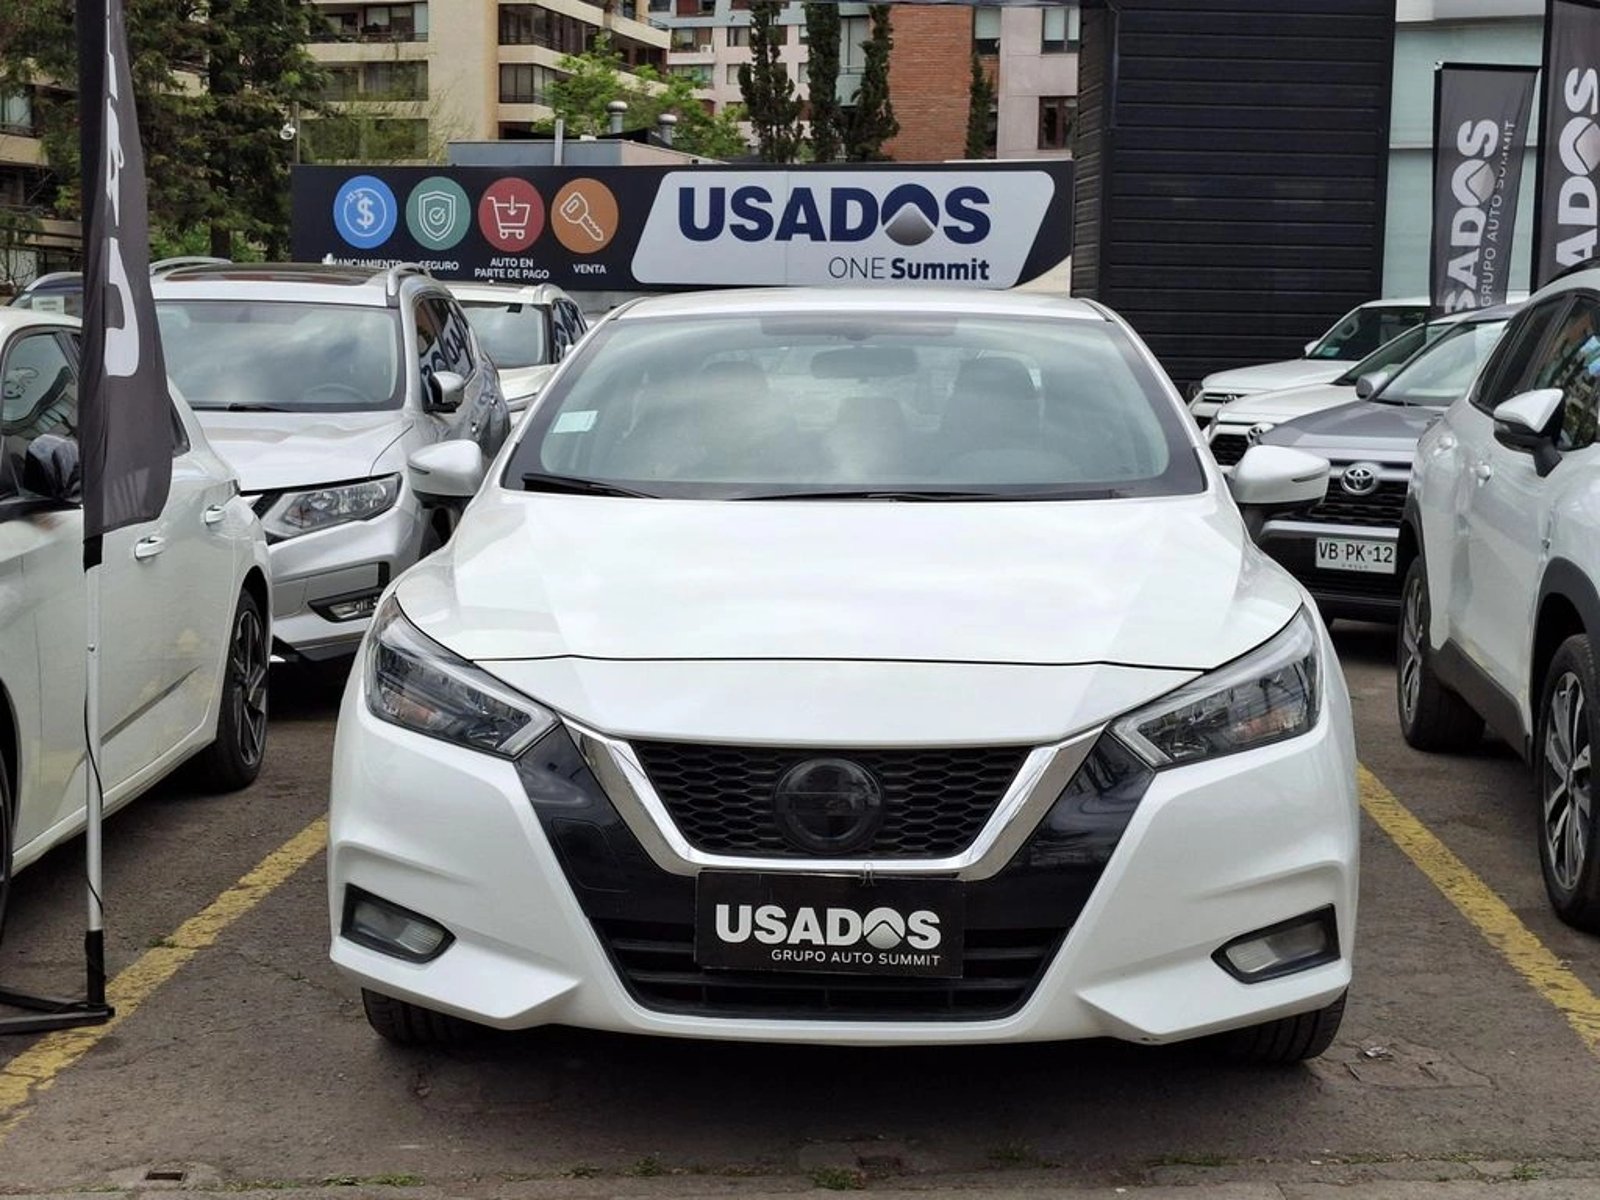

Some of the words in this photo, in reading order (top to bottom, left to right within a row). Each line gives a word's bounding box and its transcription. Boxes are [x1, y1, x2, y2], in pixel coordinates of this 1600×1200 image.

[1556, 67, 1600, 267] ADOS
[678, 183, 991, 246] USADOS
[1445, 119, 1499, 313] SADOS
[490, 257, 518, 267] AUTO
[520, 258, 534, 268] EN
[1480, 248, 1496, 307] GRUPO
[1488, 195, 1503, 241] AUTO
[419, 260, 460, 271] SEGURO
[474, 268, 505, 278] PARTE
[507, 269, 521, 279] DE
[523, 269, 550, 279] PAGO
[573, 263, 607, 274] VENTA
[828, 256, 886, 279] ONE
[890, 257, 990, 281] Summit
[715, 904, 942, 950] USADOS
[771, 949, 826, 962] GRUPO
[830, 952, 873, 964] AUTO
[878, 954, 941, 967] SUMMIT
